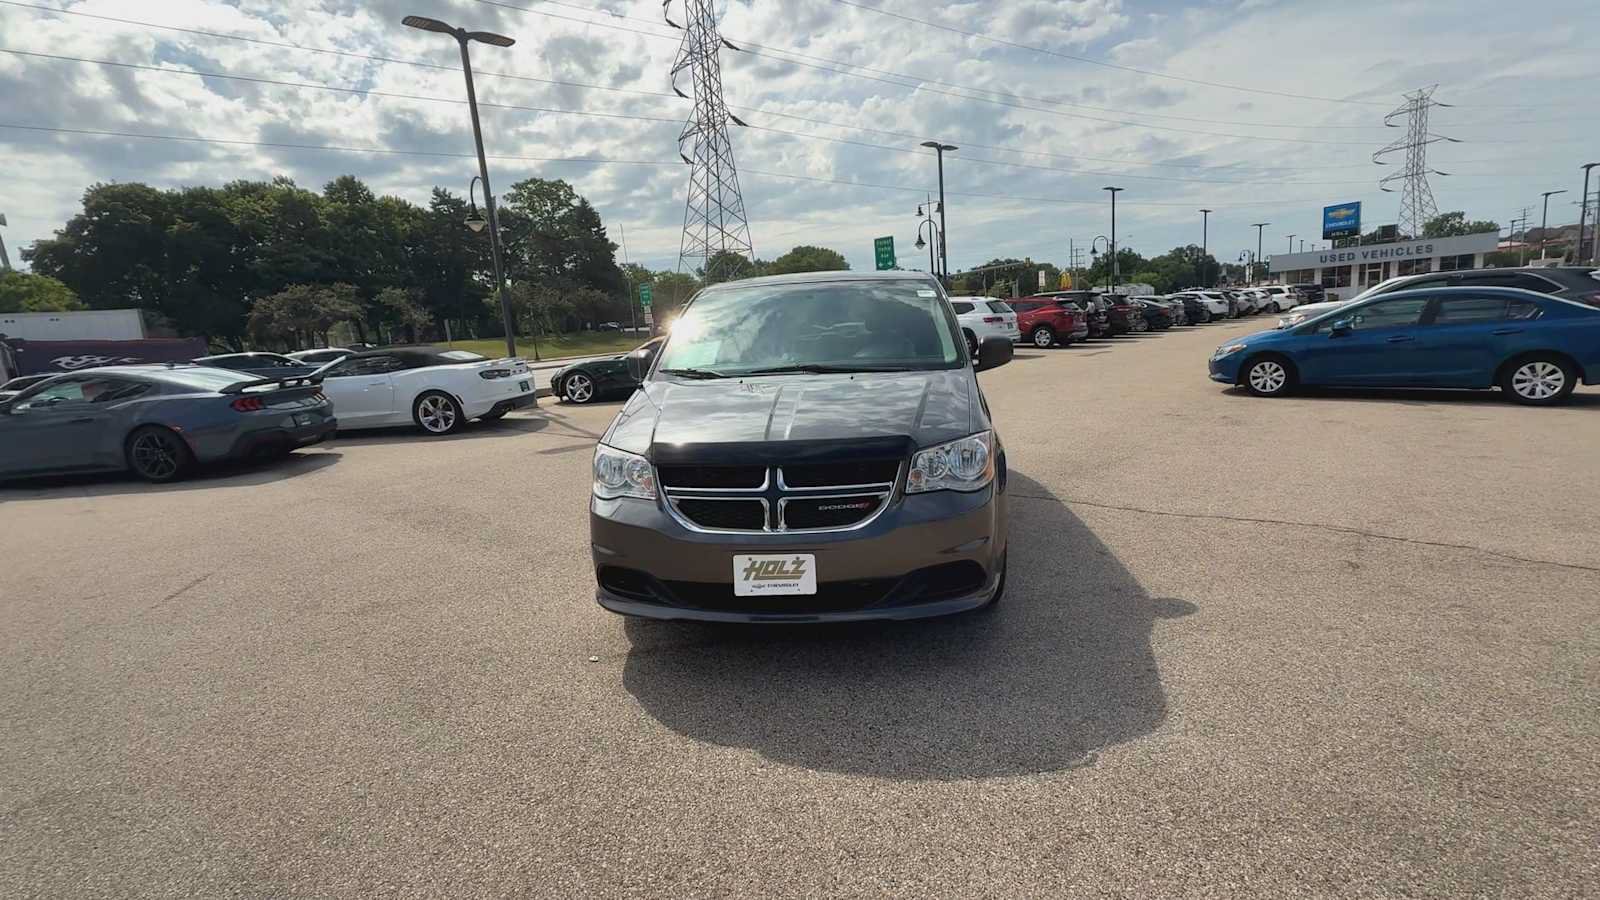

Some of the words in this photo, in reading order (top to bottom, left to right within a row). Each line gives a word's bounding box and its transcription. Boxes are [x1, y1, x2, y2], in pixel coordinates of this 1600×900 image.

[1320, 252, 1356, 264] USED
[1361, 244, 1433, 260] VEHICLES
[818, 503, 864, 511] DODGE
[743, 560, 807, 580] HOLZ
